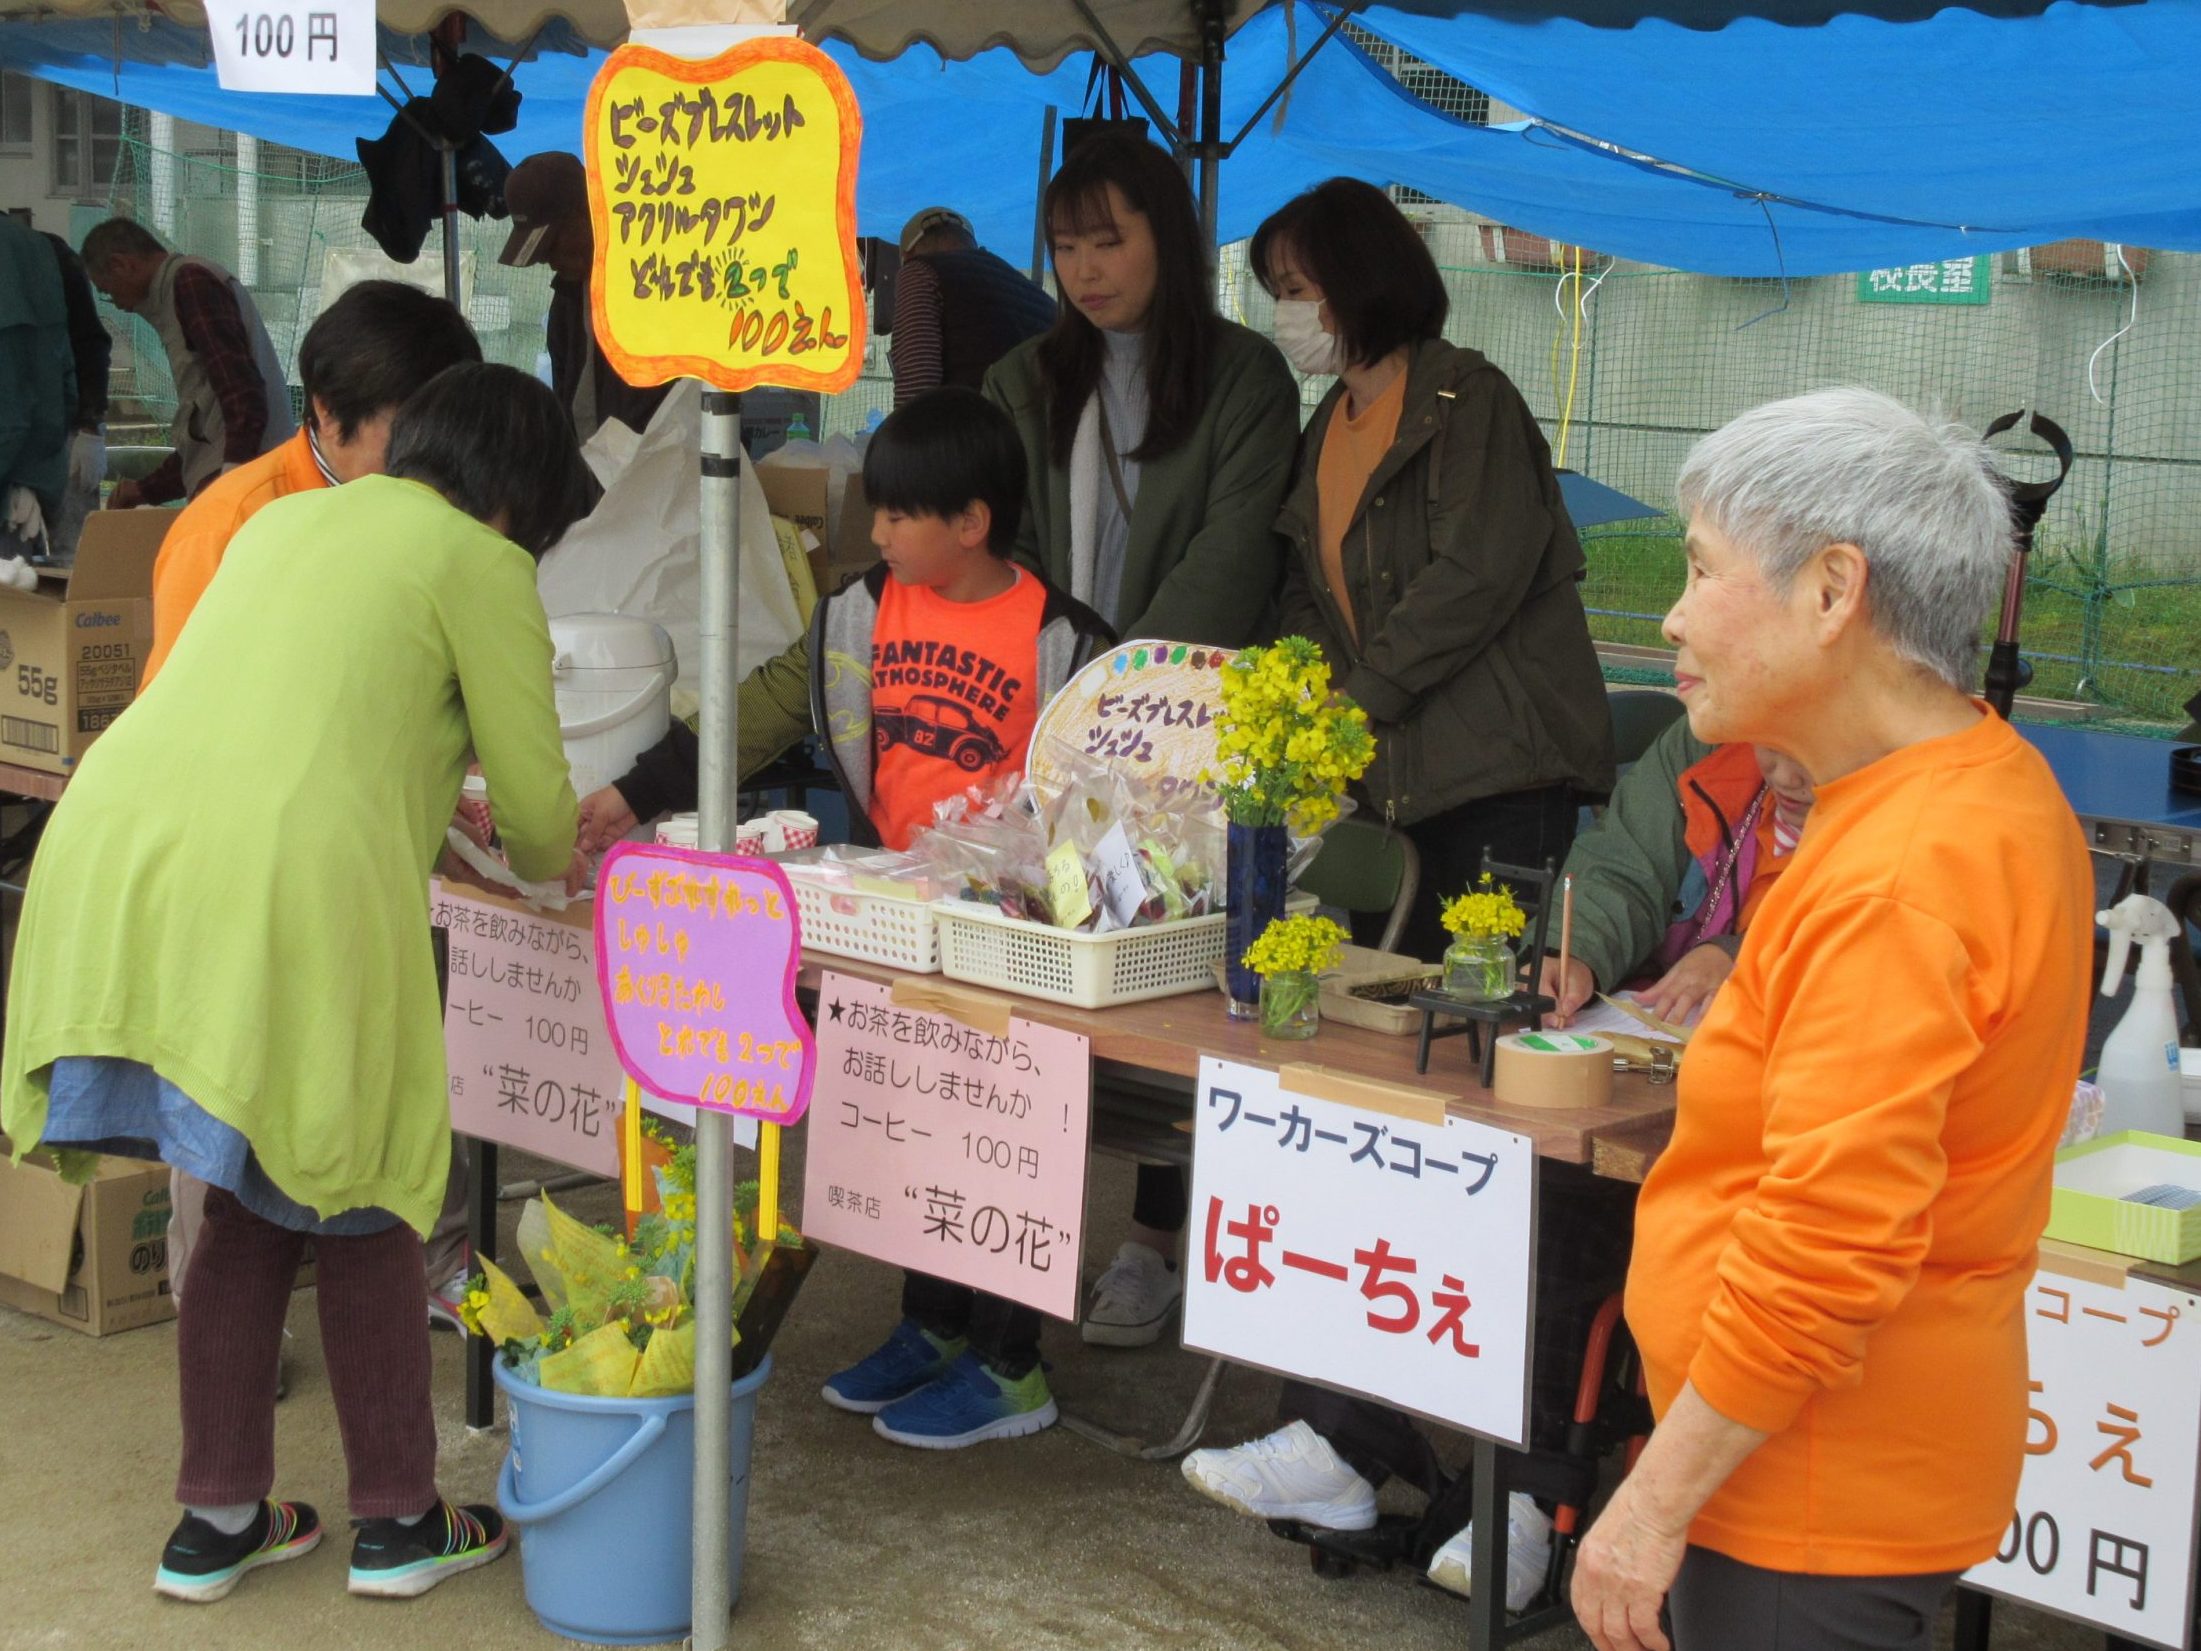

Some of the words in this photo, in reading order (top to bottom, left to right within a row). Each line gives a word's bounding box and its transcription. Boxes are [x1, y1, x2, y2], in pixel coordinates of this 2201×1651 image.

[235, 13, 338, 62] 100円
[610, 86, 805, 151] ビーズブレスレット
[614, 151, 696, 196] シュシュ
[612, 191, 775, 246] アクリルタワシ
[728, 300, 848, 356] 100えん
[76, 611, 121, 628] Calbee
[81, 643, 130, 660] 20051
[872, 640, 1021, 703] FANTASTIC
[18, 664, 58, 706] 55g
[618, 918, 689, 963] しゅしゅ
[526, 1015, 588, 1055] 100円
[700, 1073, 789, 1113] 100えん
[843, 1047, 1031, 1119] お話ししませんか
[841, 1101, 932, 1142] コーヒー
[962, 1131, 1039, 1179] 100円
[1209, 1087, 1498, 1196] ワーカーズコープ
[828, 1185, 881, 1220] 喫茶店
[1204, 1195, 1480, 1358] ぱーちぇ
[2036, 1286, 2180, 1347] コープ
